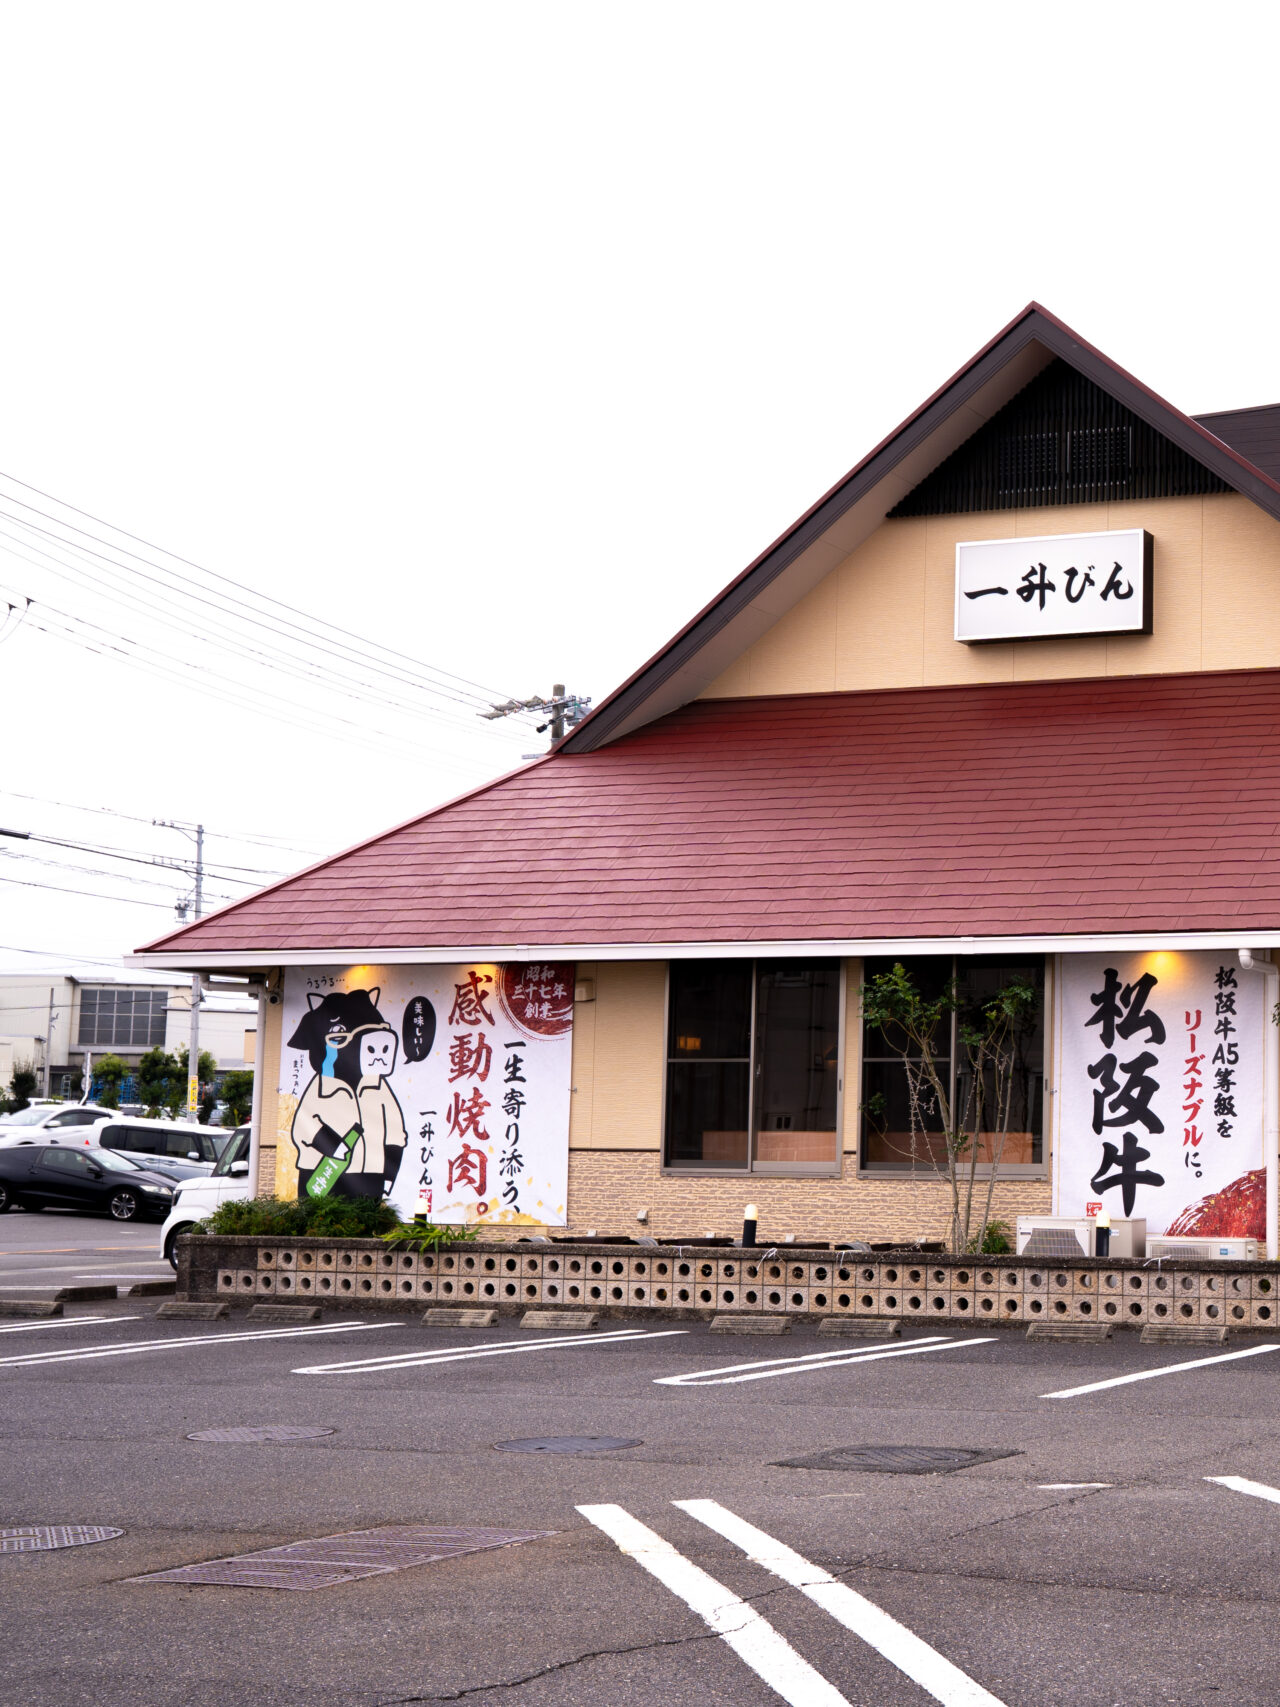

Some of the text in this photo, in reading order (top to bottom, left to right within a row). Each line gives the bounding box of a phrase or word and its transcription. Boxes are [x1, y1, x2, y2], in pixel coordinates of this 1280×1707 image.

[964, 561, 1134, 612] 一升びん
[512, 982, 567, 1000] 三十七年
[524, 1001, 552, 1018] 創業
[526, 965, 555, 982] 昭和
[446, 970, 496, 1216] 感動焼肉。
[1084, 967, 1167, 1218] 松阪牛
[1182, 1009, 1205, 1179] リーズナブルに。
[1212, 966, 1239, 1138] 松阪牛A5等級を
[419, 1110, 437, 1186] 一升びん
[499, 1041, 527, 1214] 一生寄り添う、
